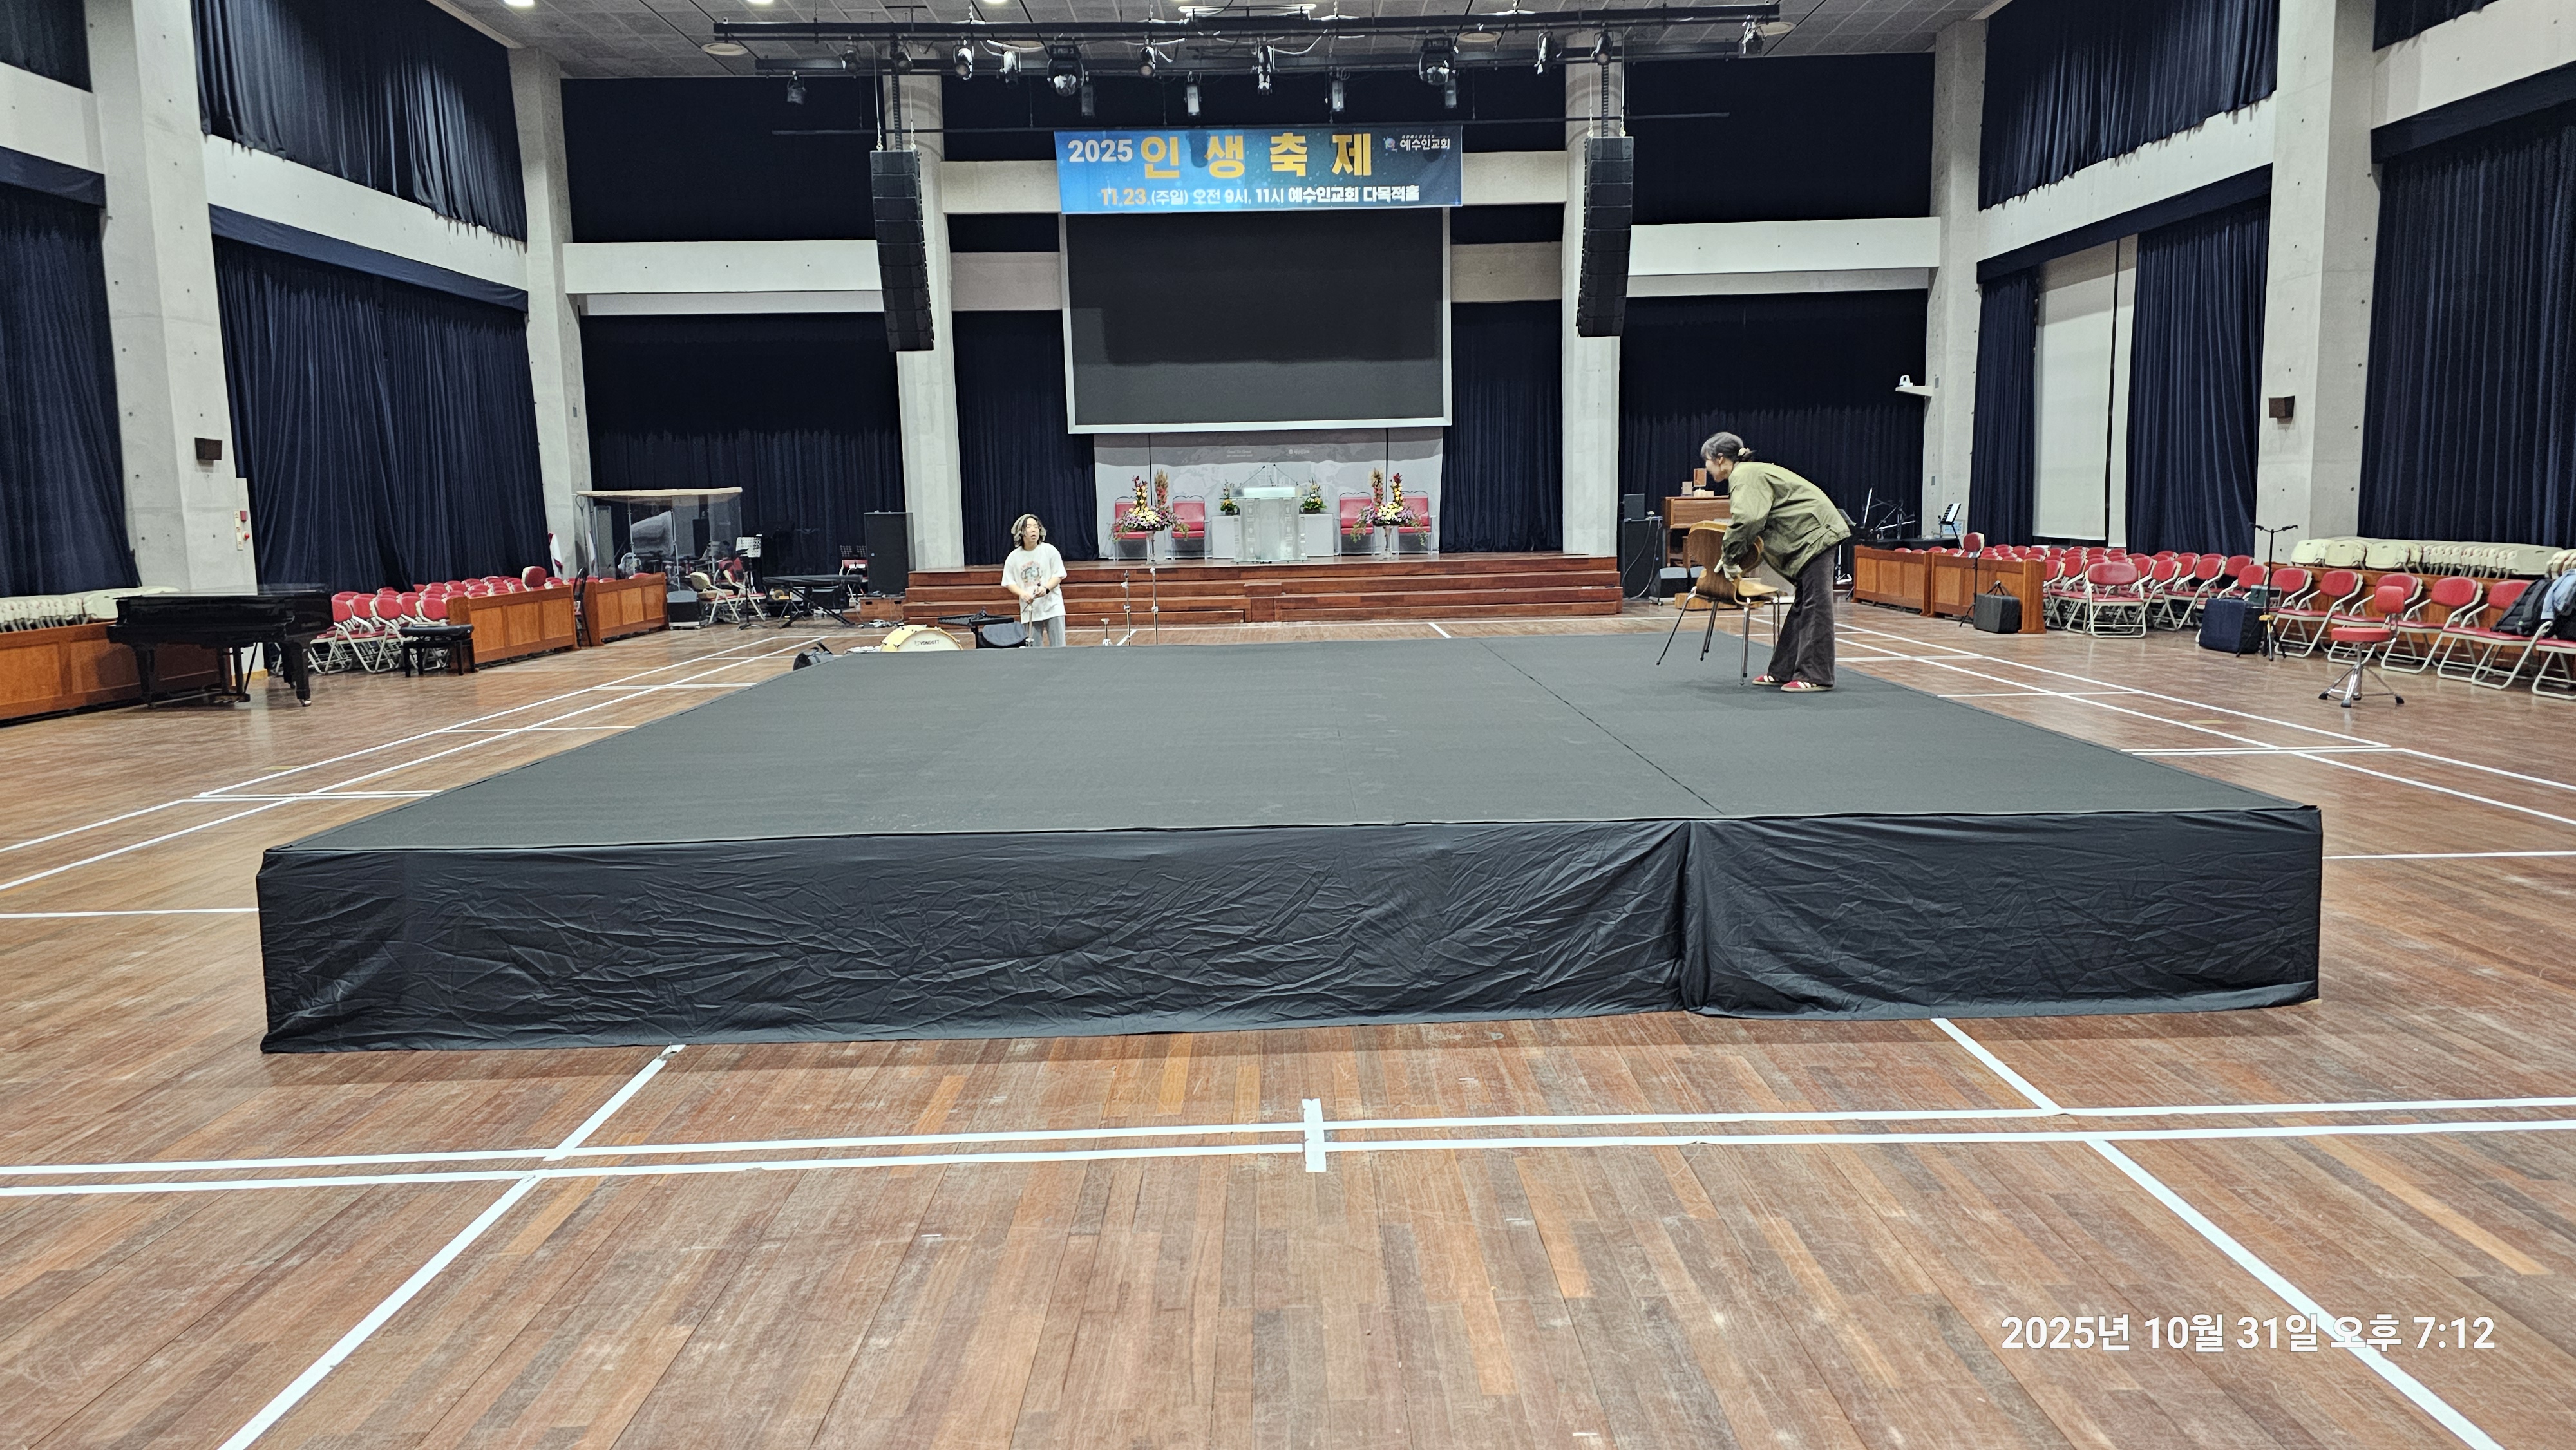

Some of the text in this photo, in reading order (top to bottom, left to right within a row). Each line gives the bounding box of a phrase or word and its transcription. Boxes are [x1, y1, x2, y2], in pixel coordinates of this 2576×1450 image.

[1068, 139, 1133, 162] 2025
[1399, 138, 1450, 151] 예수인교회
[1193, 188, 1221, 205] 오전
[1255, 187, 1284, 204] 11시
[1288, 186, 1359, 203] 예수인교회
[1363, 185, 1420, 202] 다목적홀
